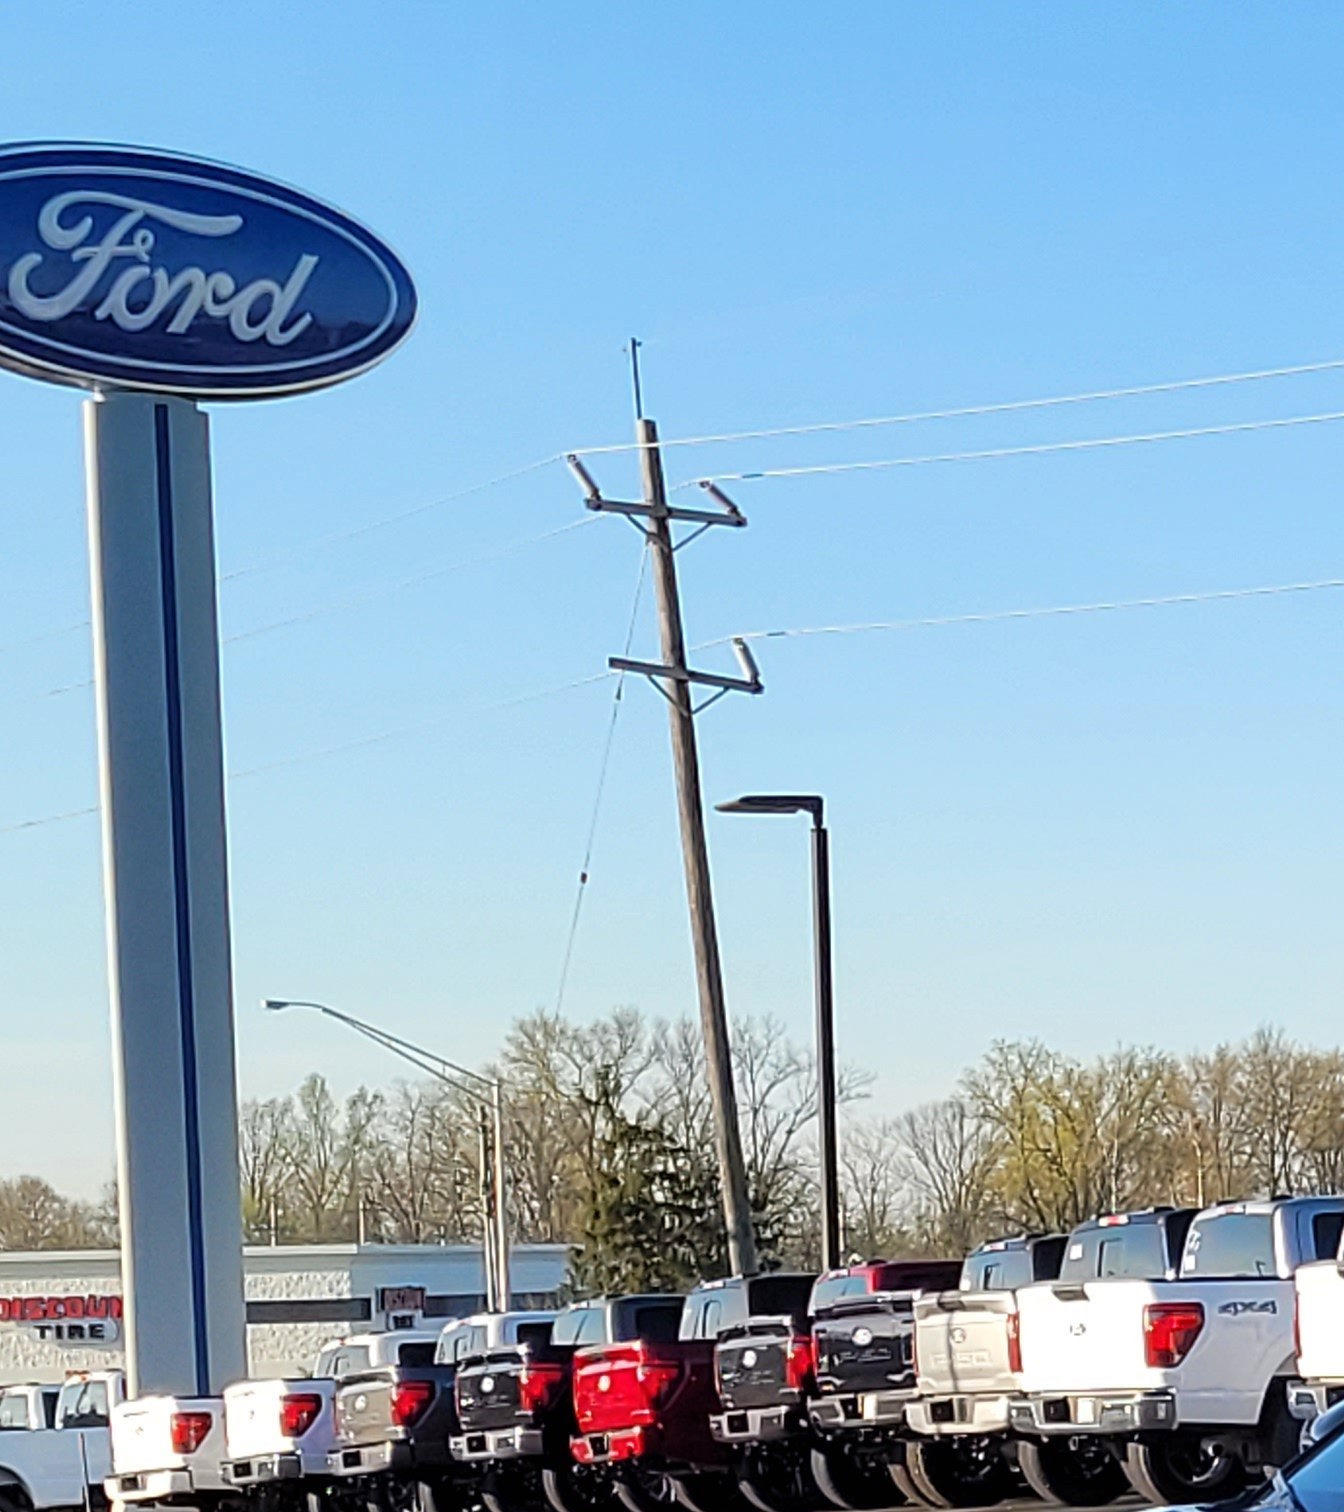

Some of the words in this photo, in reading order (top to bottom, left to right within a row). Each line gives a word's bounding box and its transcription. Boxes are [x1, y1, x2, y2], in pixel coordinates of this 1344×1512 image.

[8, 190, 320, 346] Ford
[0, 1294, 122, 1321] DISCOUN
[34, 1323, 105, 1340] TIRE
